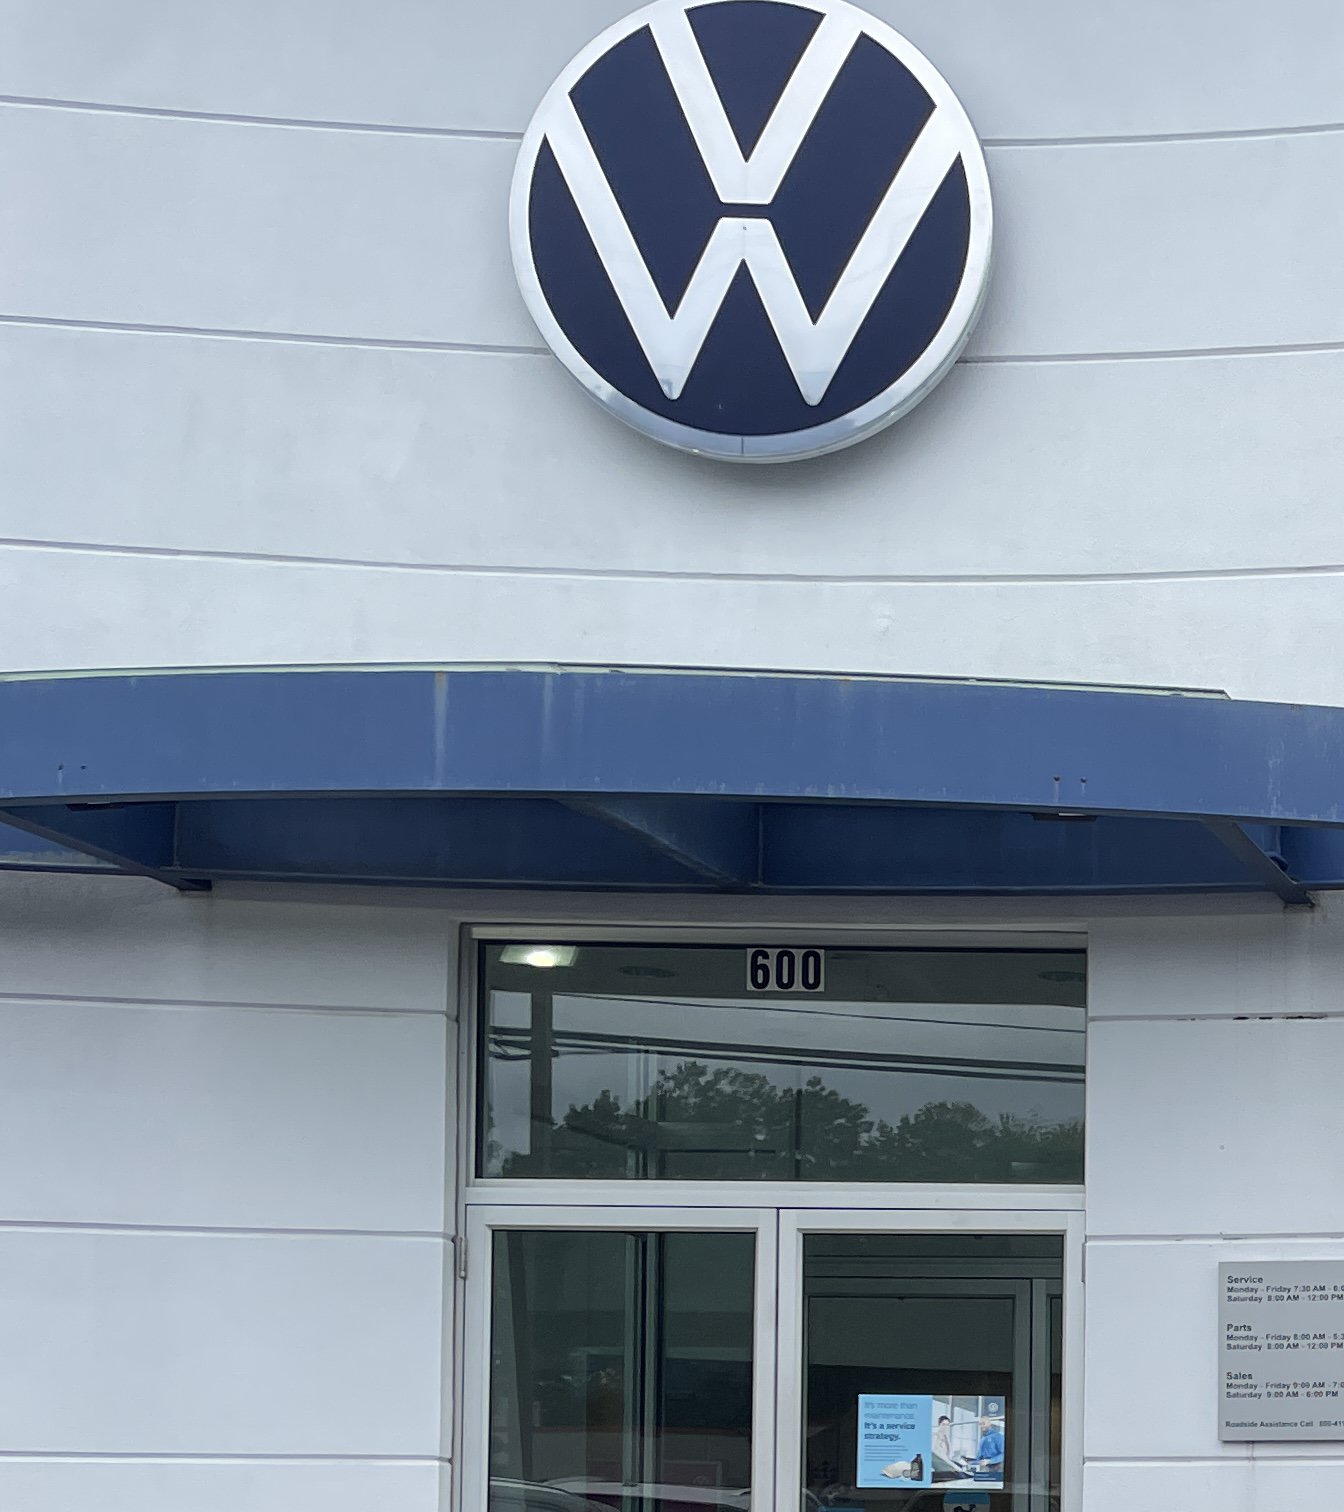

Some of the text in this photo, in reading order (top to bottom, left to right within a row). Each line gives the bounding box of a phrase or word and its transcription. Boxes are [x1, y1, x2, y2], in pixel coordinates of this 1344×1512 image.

[750, 949, 822, 990] 600
[1227, 1275, 1263, 1284] Service
[1227, 1286, 1259, 1294] Monday
[1266, 1286, 1291, 1294] Friday
[1227, 1295, 1263, 1303] Saturday
[1331, 1293, 1344, 1301] PM
[1226, 1323, 1252, 1332] Parts
[1226, 1334, 1258, 1342] Monday
[1226, 1343, 1262, 1351] Saturday
[1226, 1372, 1253, 1380] Sales
[1226, 1382, 1258, 1390] Monday
[1265, 1382, 1291, 1390] Friday
[1226, 1391, 1262, 1400] Saturday
[1325, 1390, 1339, 1398] PM
[886, 1422, 916, 1430] service
[1259, 1420, 1298, 1428] Assistance
